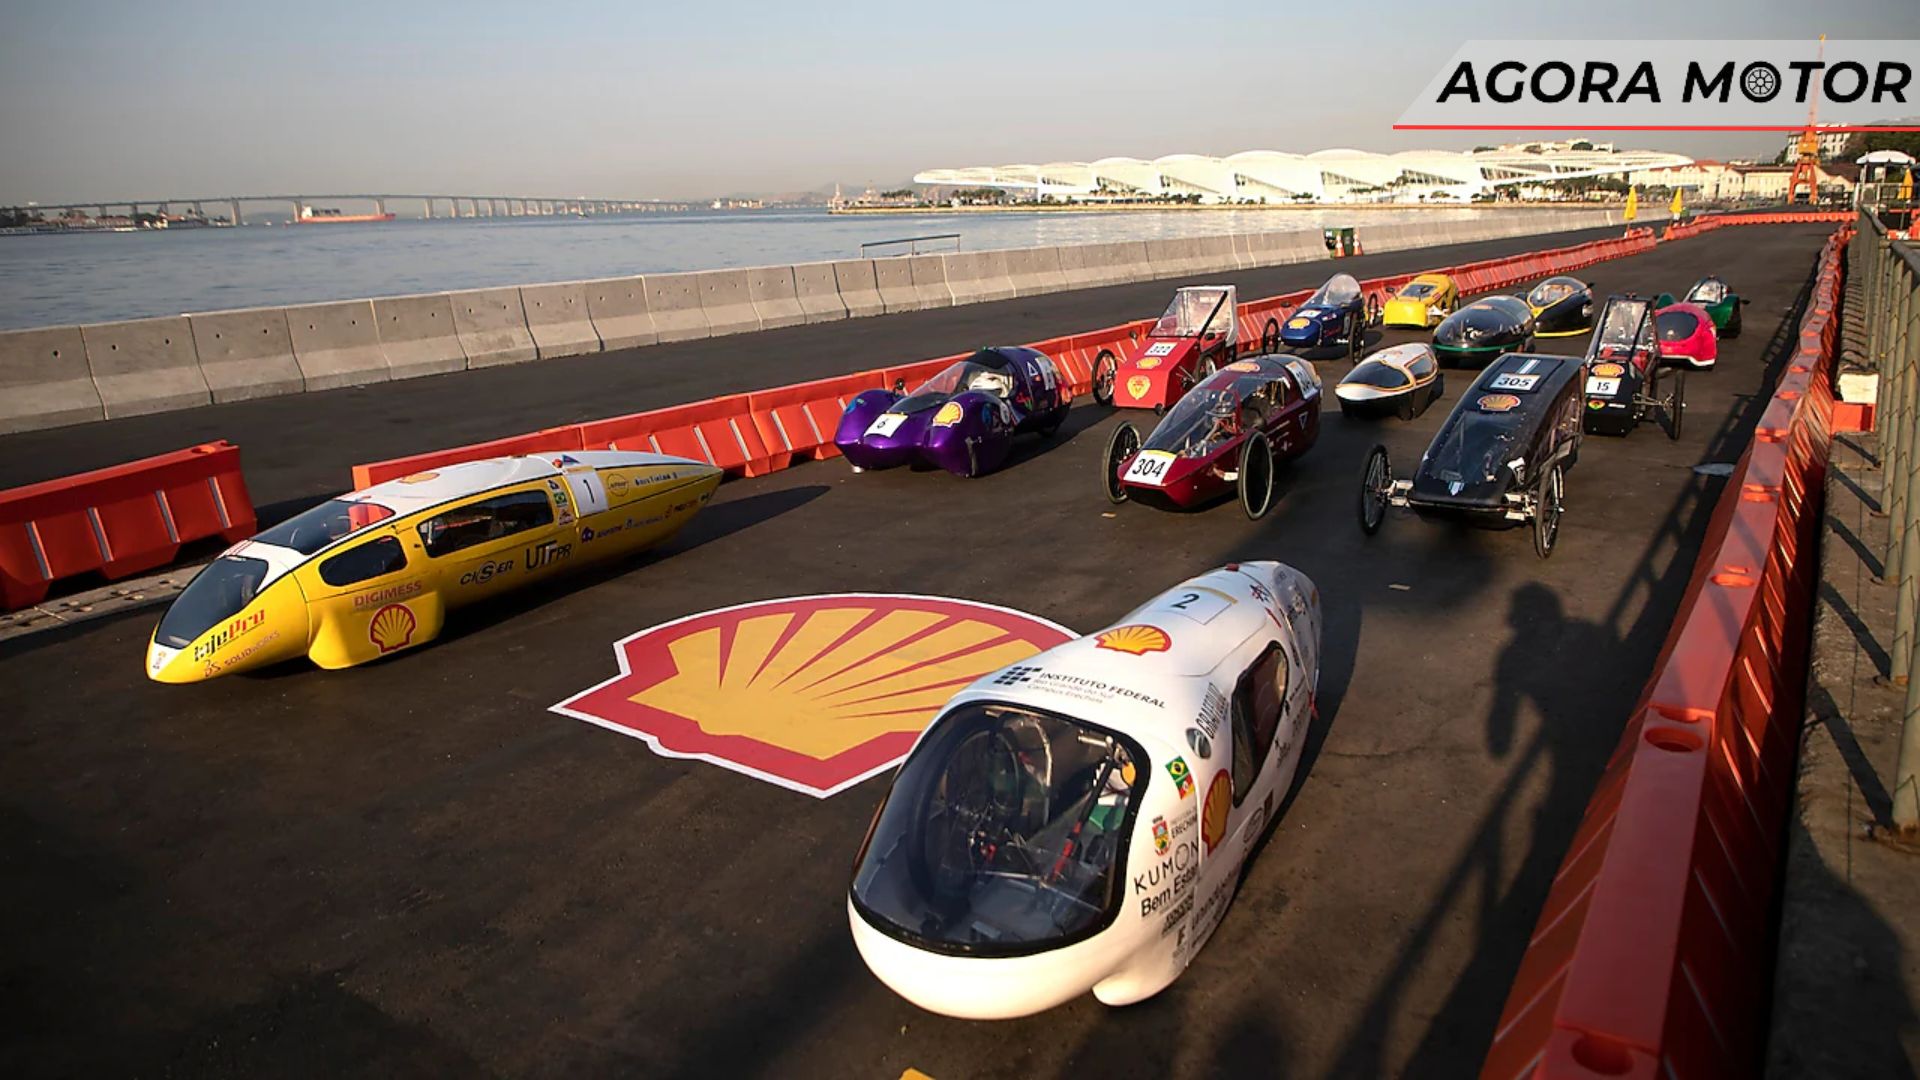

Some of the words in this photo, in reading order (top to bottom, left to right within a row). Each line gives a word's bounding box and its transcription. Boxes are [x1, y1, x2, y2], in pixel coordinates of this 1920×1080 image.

[1497, 377, 1532, 388] 305
[1596, 381, 1610, 392] 15
[1131, 458, 1166, 478] 304
[353, 580, 422, 608] DIGIMESS
[1172, 593, 1200, 610] 2
[1039, 671, 1107, 690] INSTITUTO
[1107, 684, 1167, 710] FEDERAL
[1141, 886, 1172, 919] Bem
